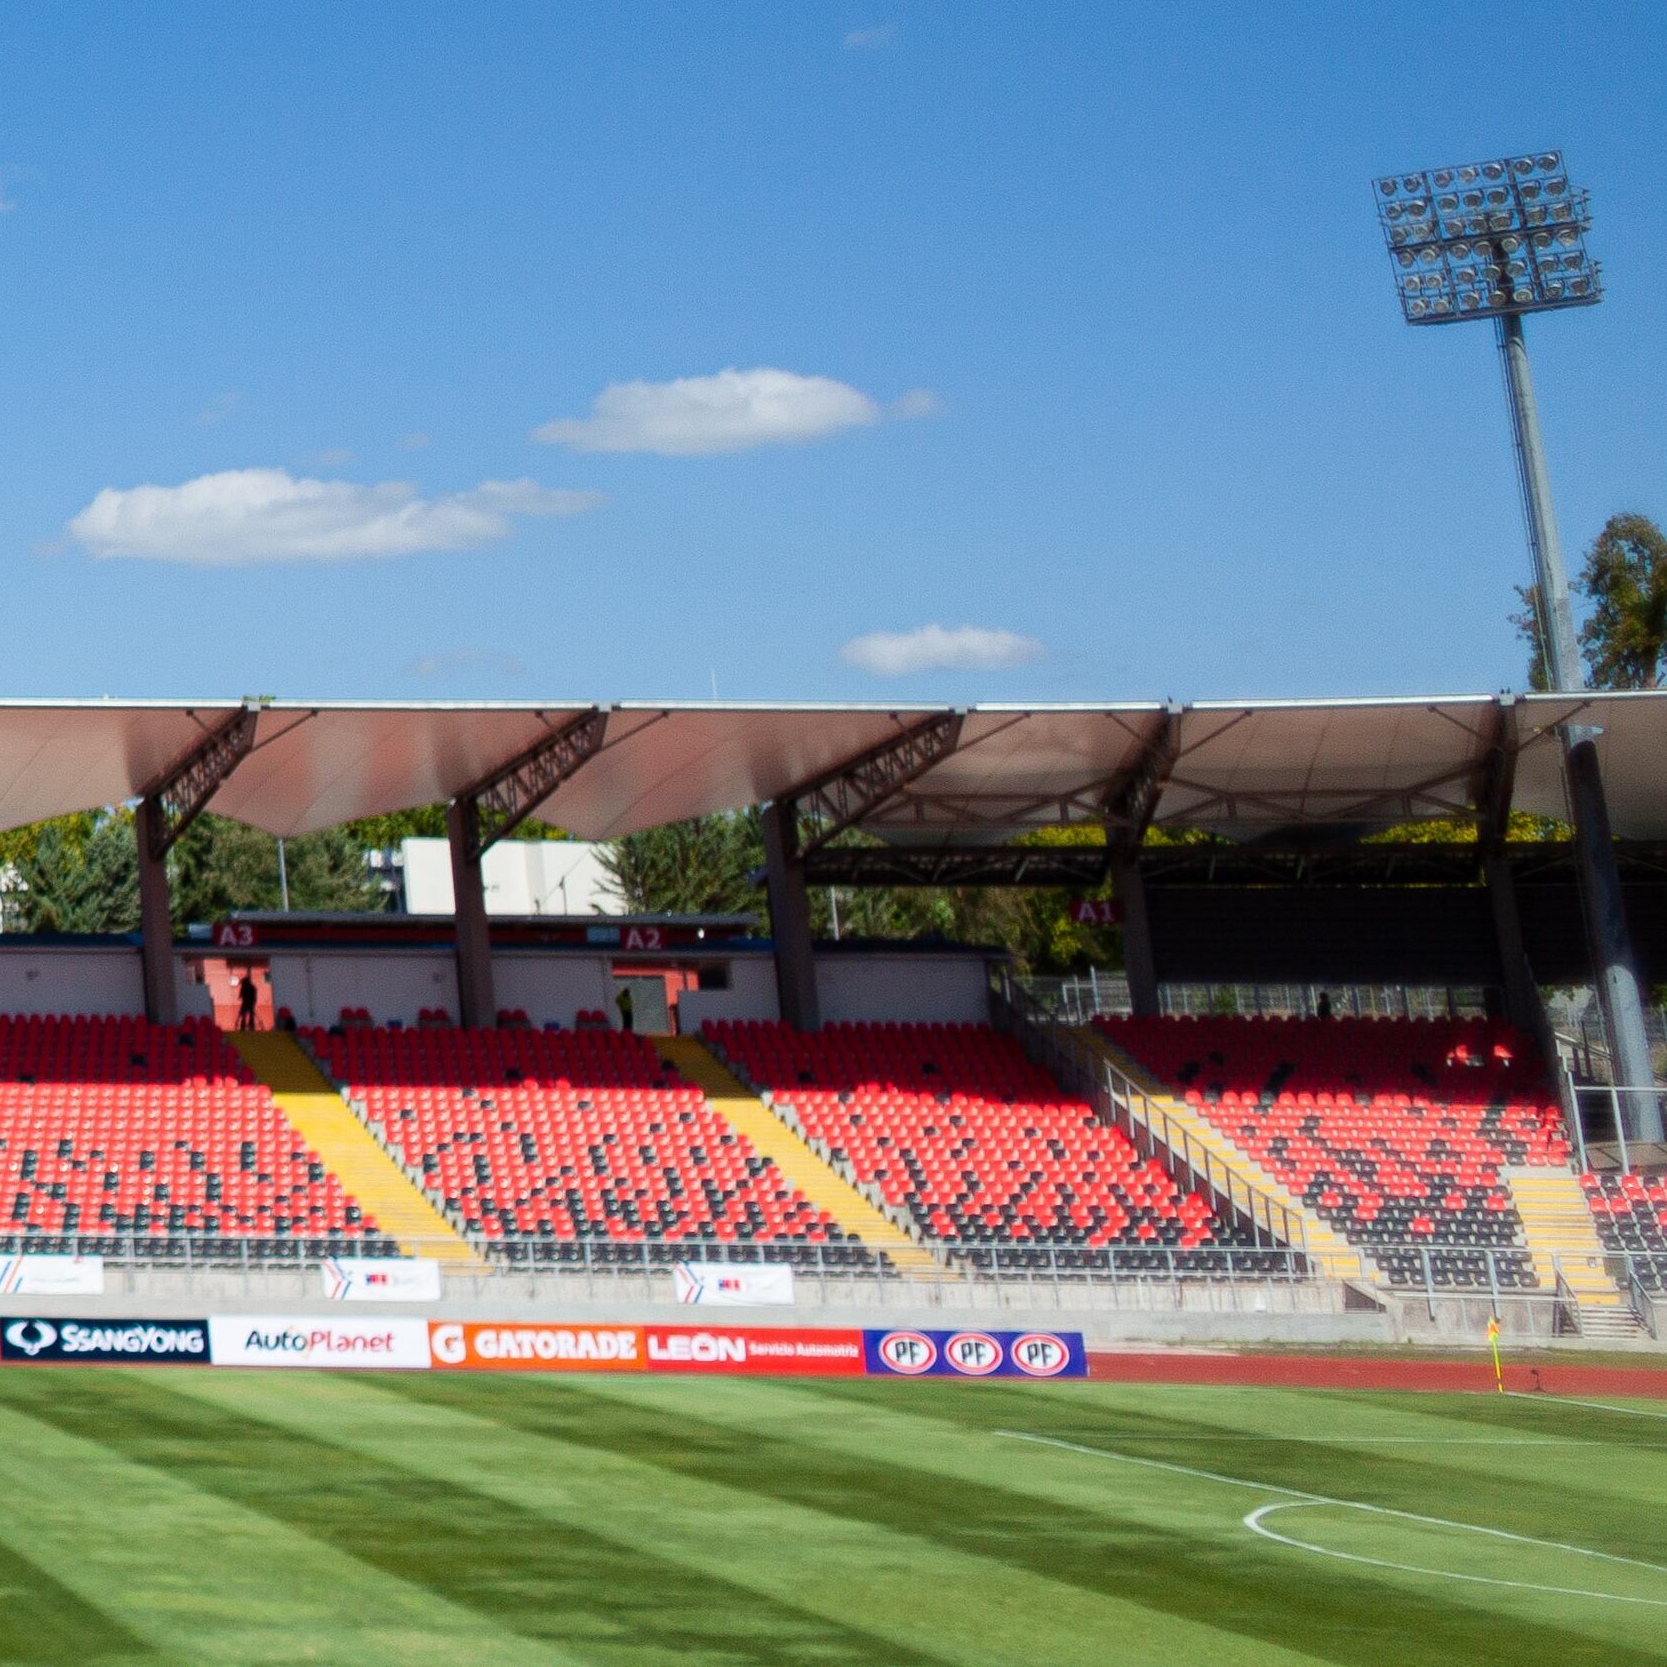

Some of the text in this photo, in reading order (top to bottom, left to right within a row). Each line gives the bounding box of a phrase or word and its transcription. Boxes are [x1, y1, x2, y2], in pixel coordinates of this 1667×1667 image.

[1078, 902, 1115, 922] A1
[219, 926, 254, 946] A3
[626, 927, 663, 950] A2
[245, 1328, 396, 1354] AutoPlanet
[431, 1323, 638, 1364] G GATORADE
[894, 1340, 922, 1366] PF
[960, 1341, 987, 1366] PF
[1026, 1342, 1053, 1367] PF
